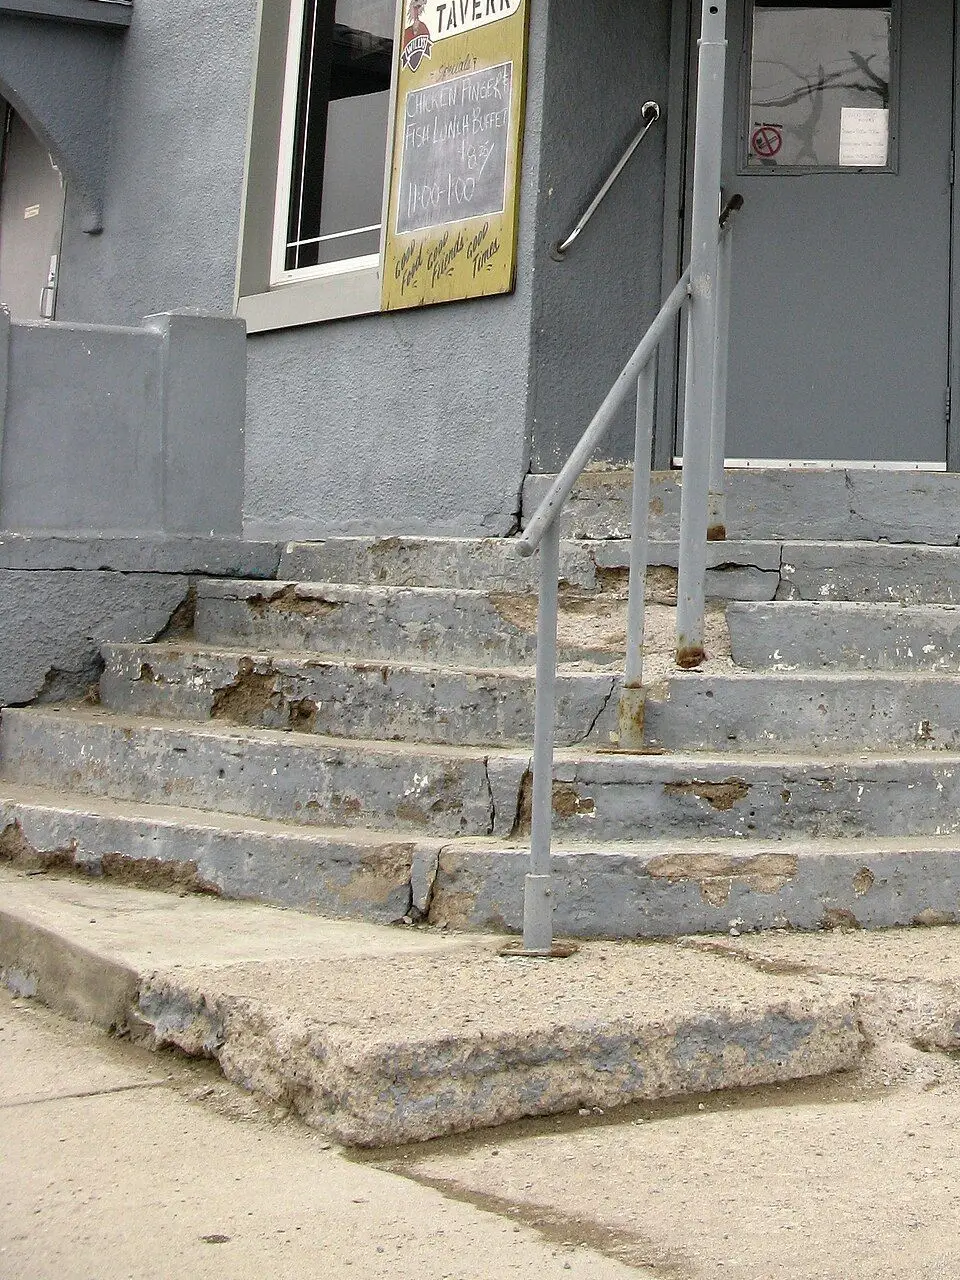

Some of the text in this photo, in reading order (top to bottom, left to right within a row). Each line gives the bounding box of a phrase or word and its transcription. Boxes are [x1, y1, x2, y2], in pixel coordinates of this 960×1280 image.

[406, 84, 457, 118] CHICKEN
[405, 107, 508, 150] FISH LUNCH BUFFET
